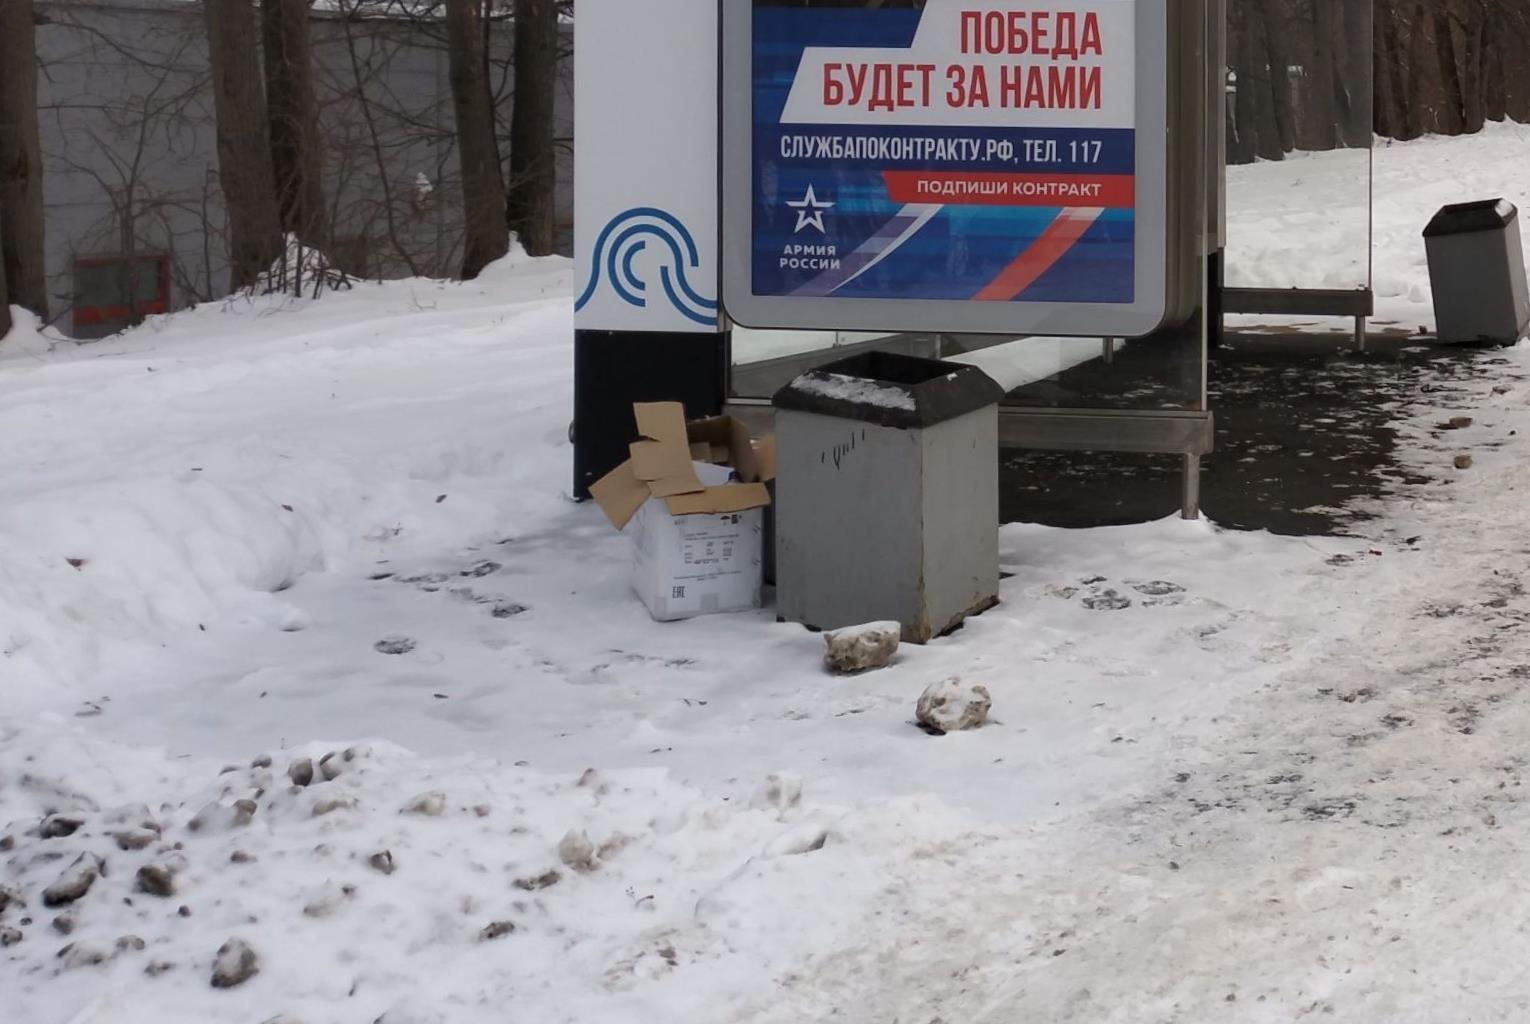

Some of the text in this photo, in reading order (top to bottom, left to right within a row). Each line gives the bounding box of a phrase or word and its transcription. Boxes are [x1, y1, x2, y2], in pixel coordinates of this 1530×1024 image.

[960, 11, 1103, 60] ПОБЕДА
[823, 63, 1102, 112] БУДЕТ ЗА НАМИ
[780, 135, 1102, 164] СЛУЖБАПОКОНТРАКТУ.РФ, ТЕЛ. 117
[917, 179, 1102, 197] ПОДПИШИ КОНТРАКТ
[783, 244, 836, 257] АРМИЯ
[779, 257, 841, 270] РОССИИ
